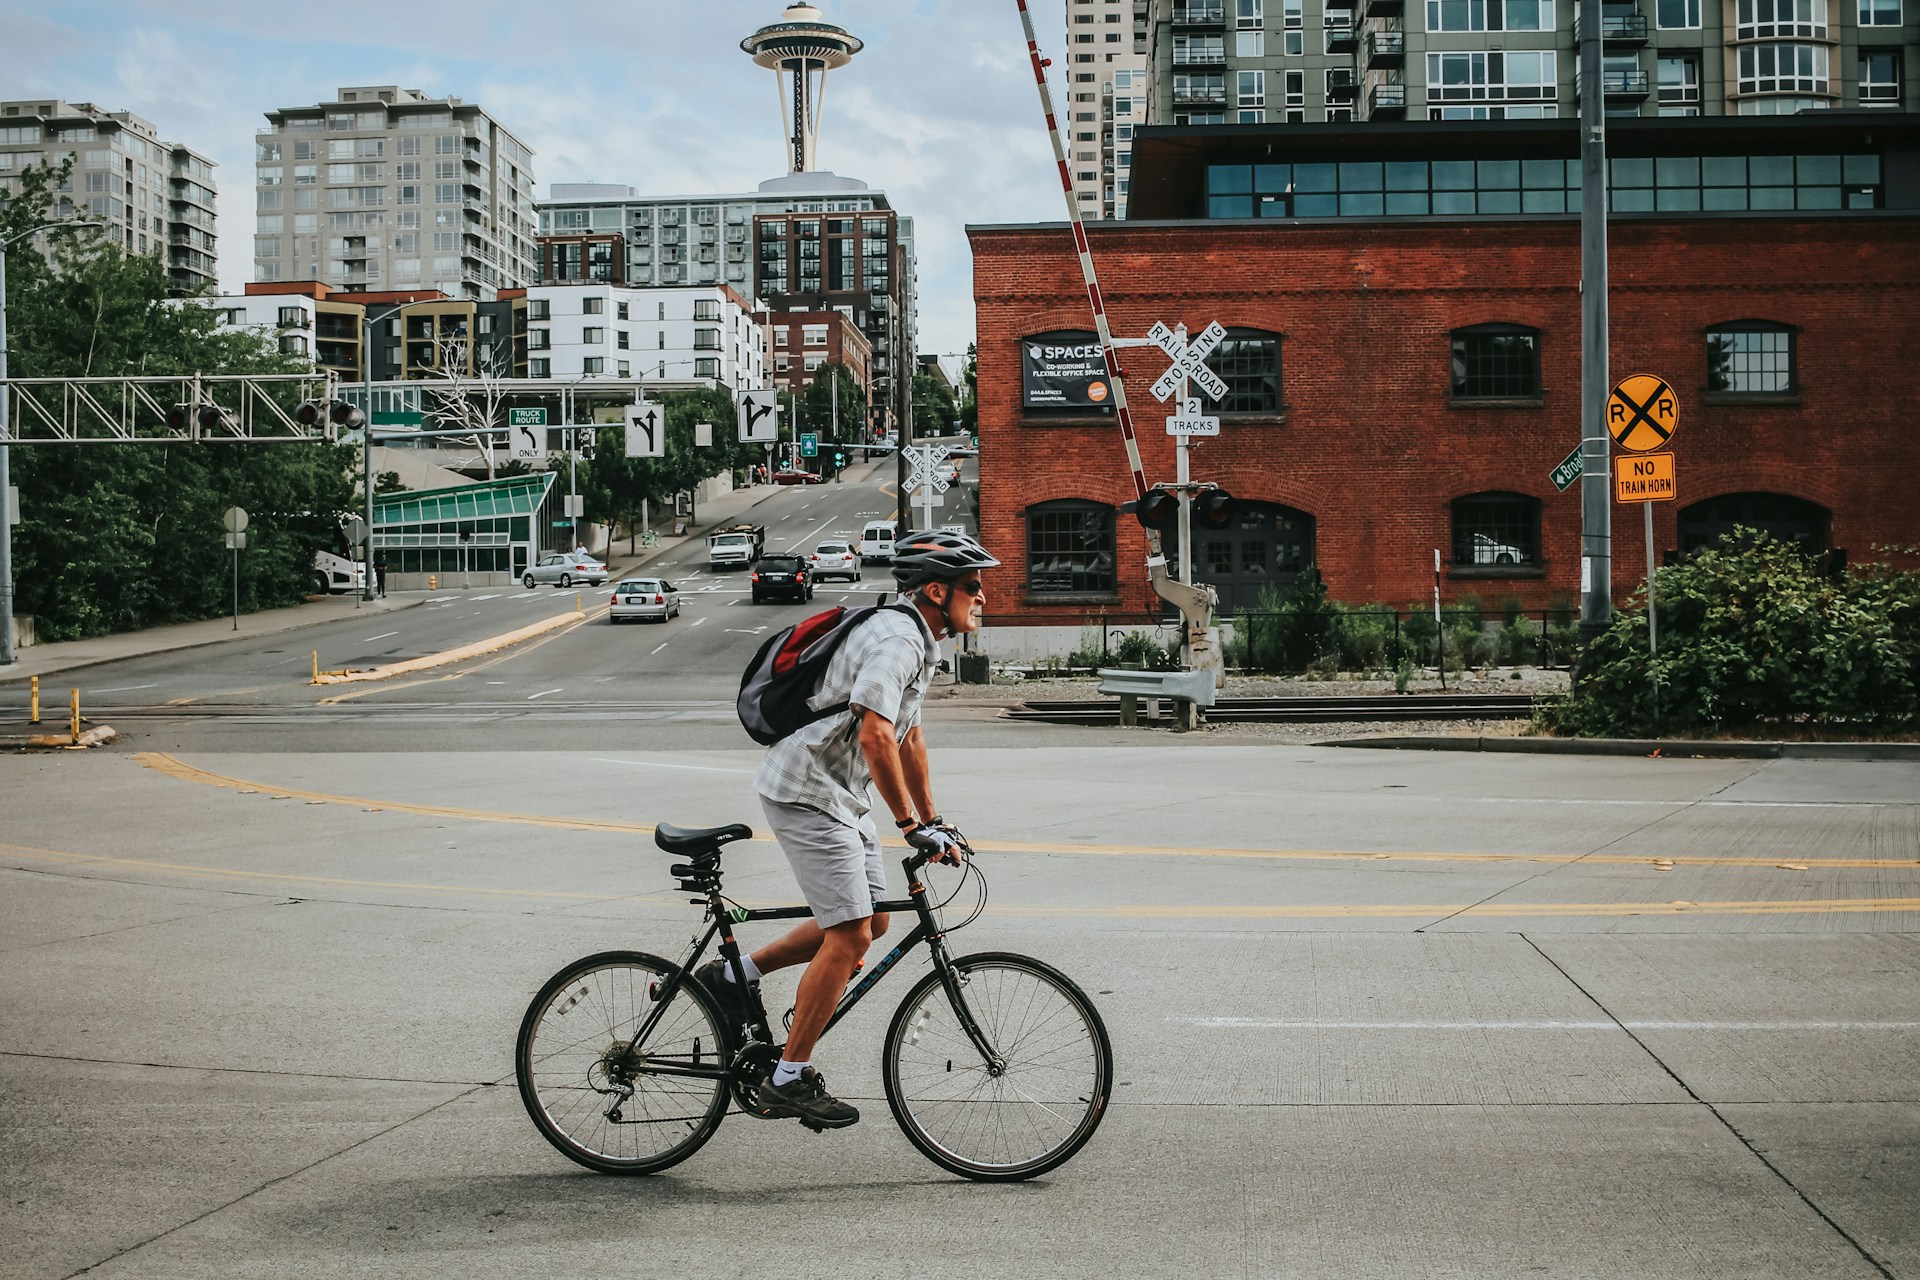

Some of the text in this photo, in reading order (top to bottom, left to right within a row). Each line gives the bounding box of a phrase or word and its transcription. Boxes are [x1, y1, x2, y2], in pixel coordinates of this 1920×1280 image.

[1044, 345, 1103, 359] SPACES
[1155, 325, 1222, 397] CROSSING
[1188, 400, 1197, 413] 2
[1173, 421, 1213, 430] TRACKS
[1634, 461, 1655, 476] NO
[1620, 478, 1671, 494] TRAIN HORN
